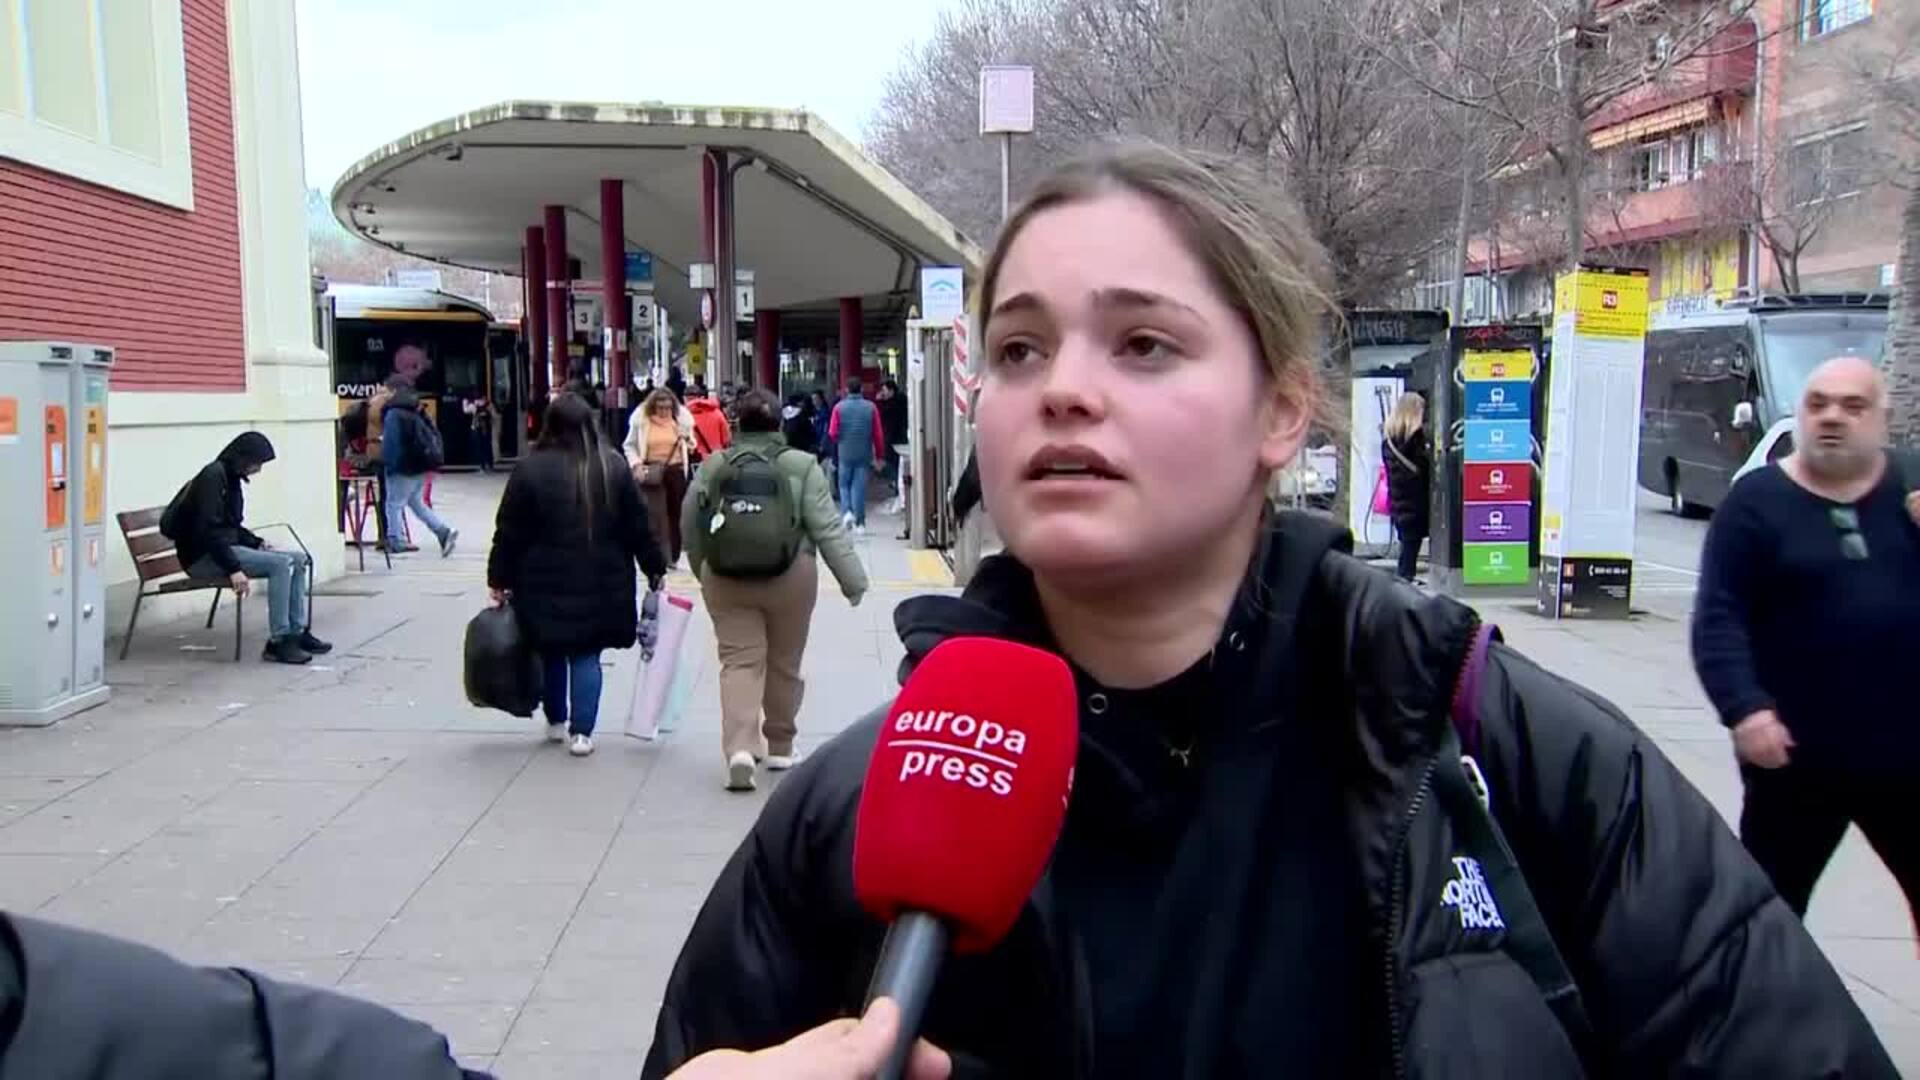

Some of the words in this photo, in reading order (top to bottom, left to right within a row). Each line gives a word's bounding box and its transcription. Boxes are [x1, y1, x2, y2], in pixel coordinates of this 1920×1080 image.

[742, 292, 749, 307] 1
[580, 312, 589, 324] 3
[638, 304, 649, 318] 2
[895, 710, 1027, 754] europa
[899, 751, 1013, 795] press
[1451, 856, 1485, 881] THE
